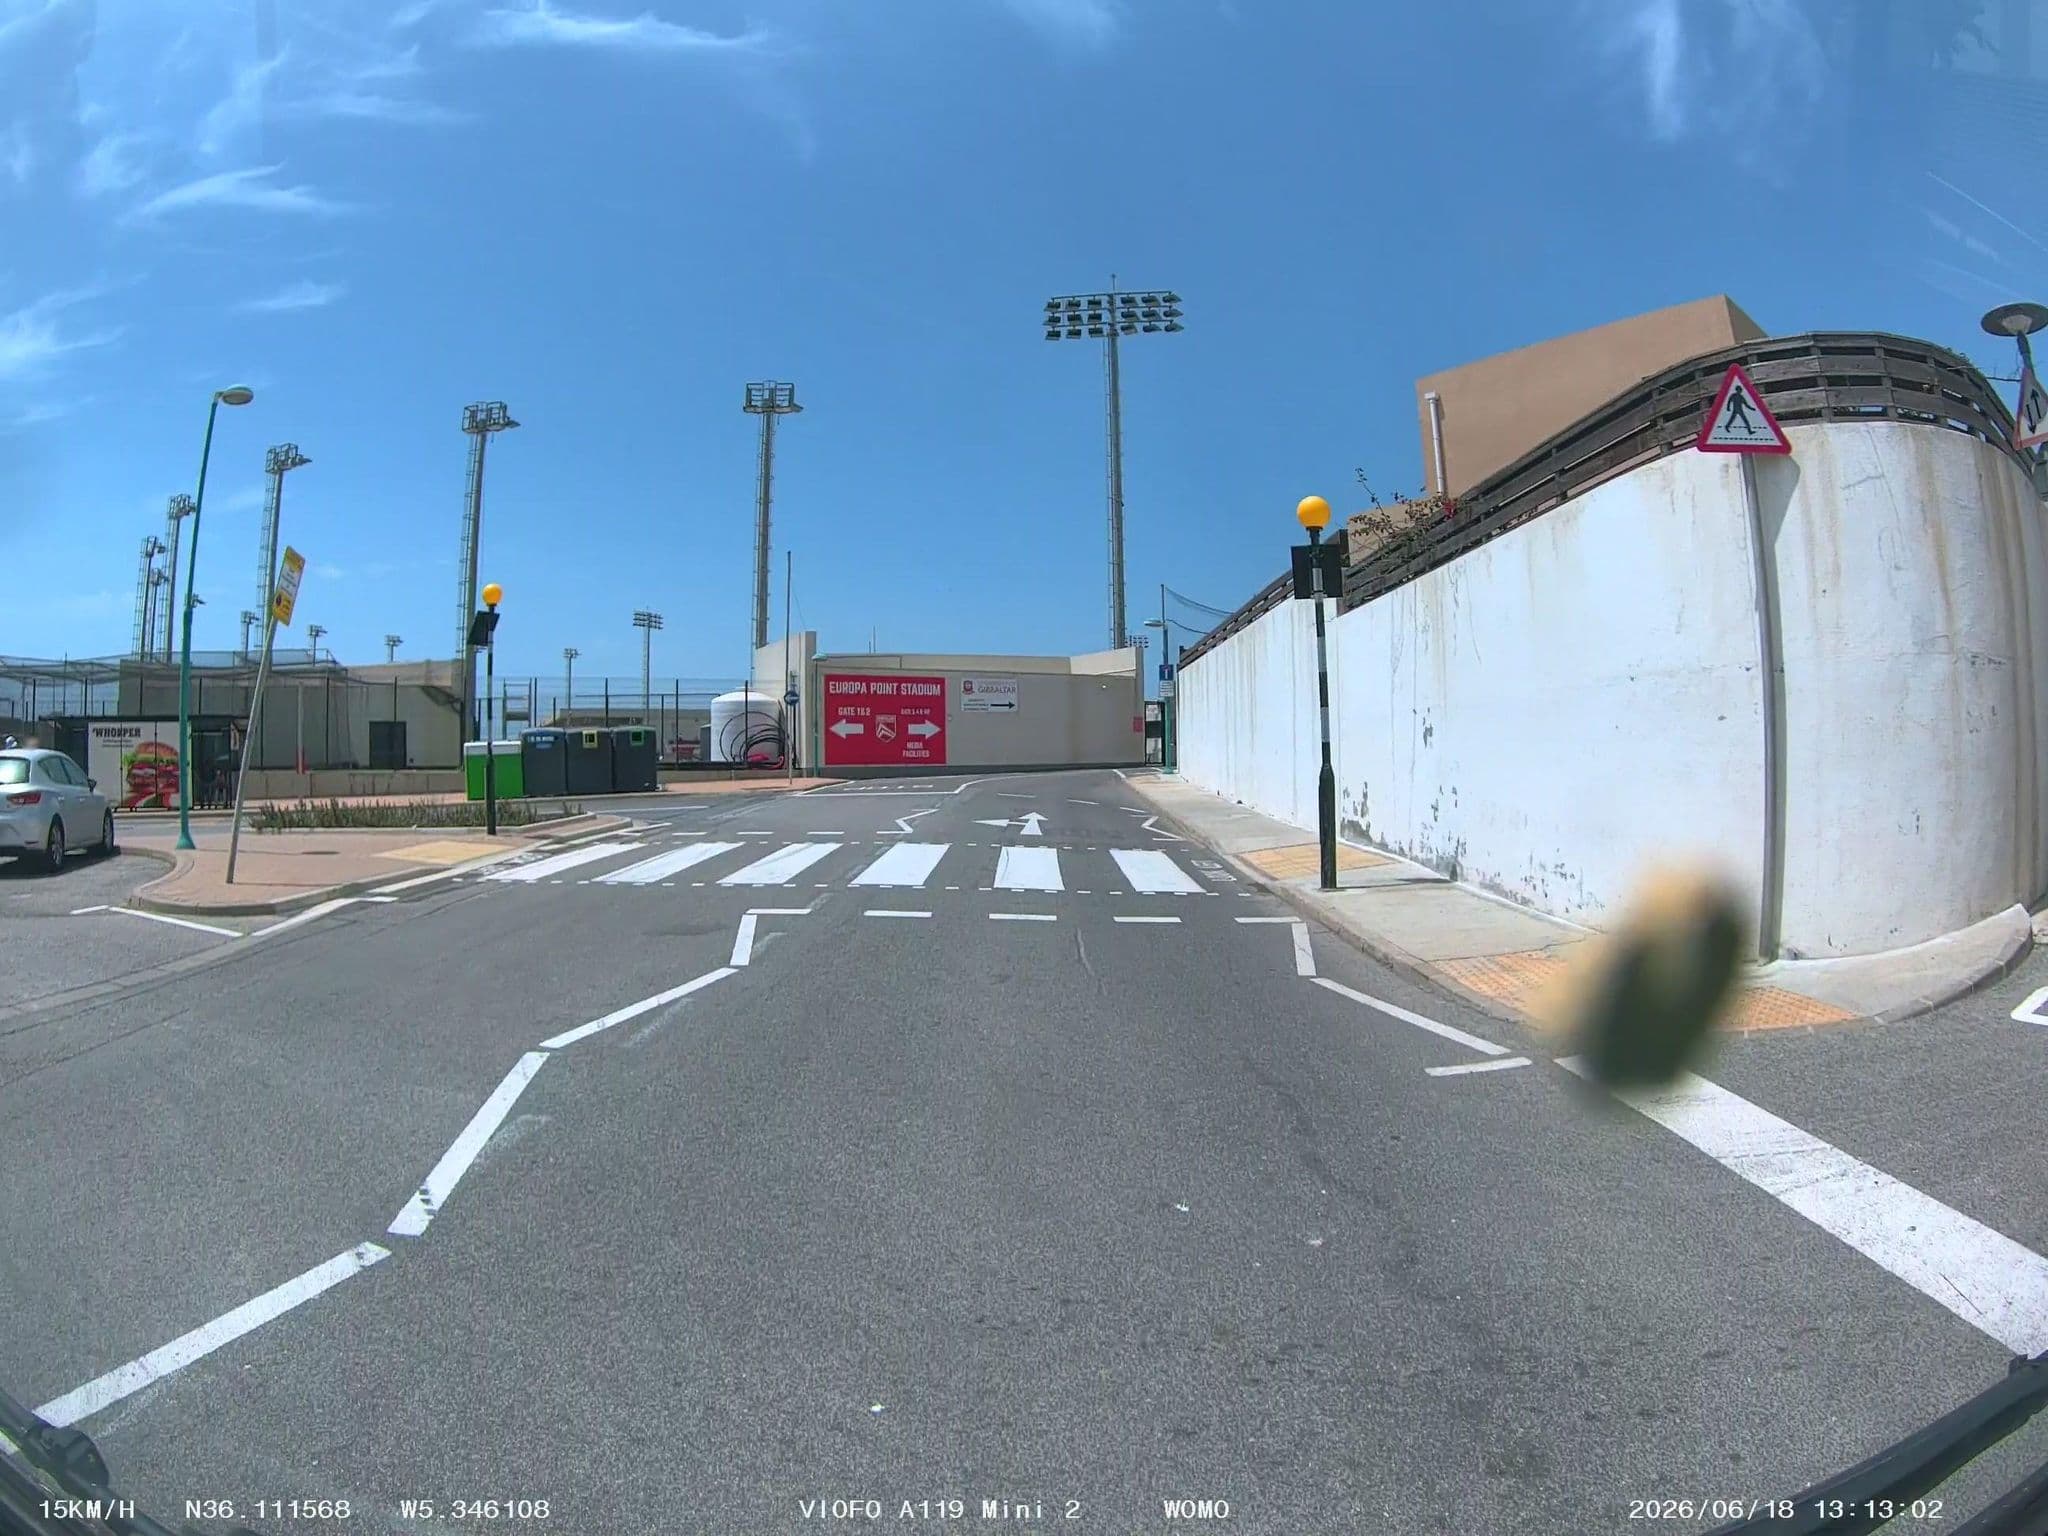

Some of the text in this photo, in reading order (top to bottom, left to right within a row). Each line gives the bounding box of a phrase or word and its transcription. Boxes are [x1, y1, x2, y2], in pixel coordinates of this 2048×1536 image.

[829, 681, 941, 696] EUROPA POINT STADIUM
[978, 686, 1017, 695] GIBRALTAR
[838, 707, 855, 716] GATE
